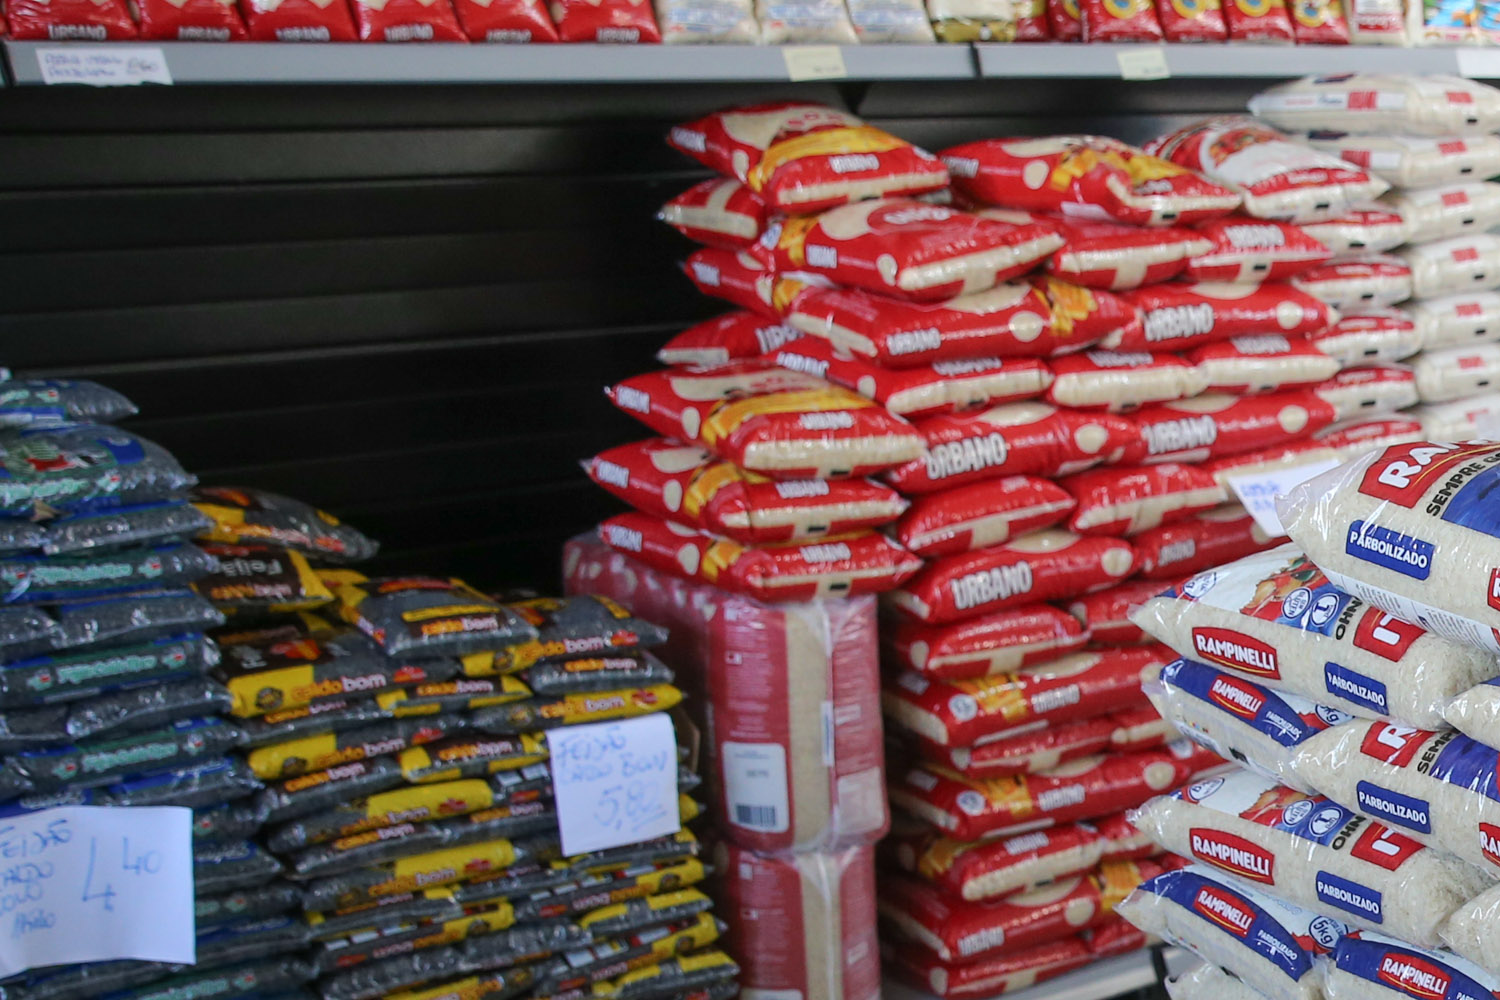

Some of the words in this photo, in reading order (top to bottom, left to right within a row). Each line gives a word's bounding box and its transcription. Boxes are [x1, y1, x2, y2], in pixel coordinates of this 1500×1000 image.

[1426, 460, 1486, 517] SEMPRE
[1350, 532, 1428, 569] PARBOILIZADO
[951, 560, 1032, 610] URBANO
[1196, 633, 1276, 671] RAMPINELLI
[1213, 677, 1263, 713] RAMPINELLI
[1417, 729, 1460, 774] SEMP
[1359, 791, 1427, 824] PARBOILIZADO
[1192, 838, 1270, 876] RAMPINELLI
[1198, 889, 1252, 932] RAMPINELLI
[1318, 880, 1380, 914] PARBOILIZADO
[1257, 928, 1298, 961] PARBOILIZADO
[1314, 919, 1333, 945] 5kg
[1382, 957, 1448, 995] RAMPINELLI
